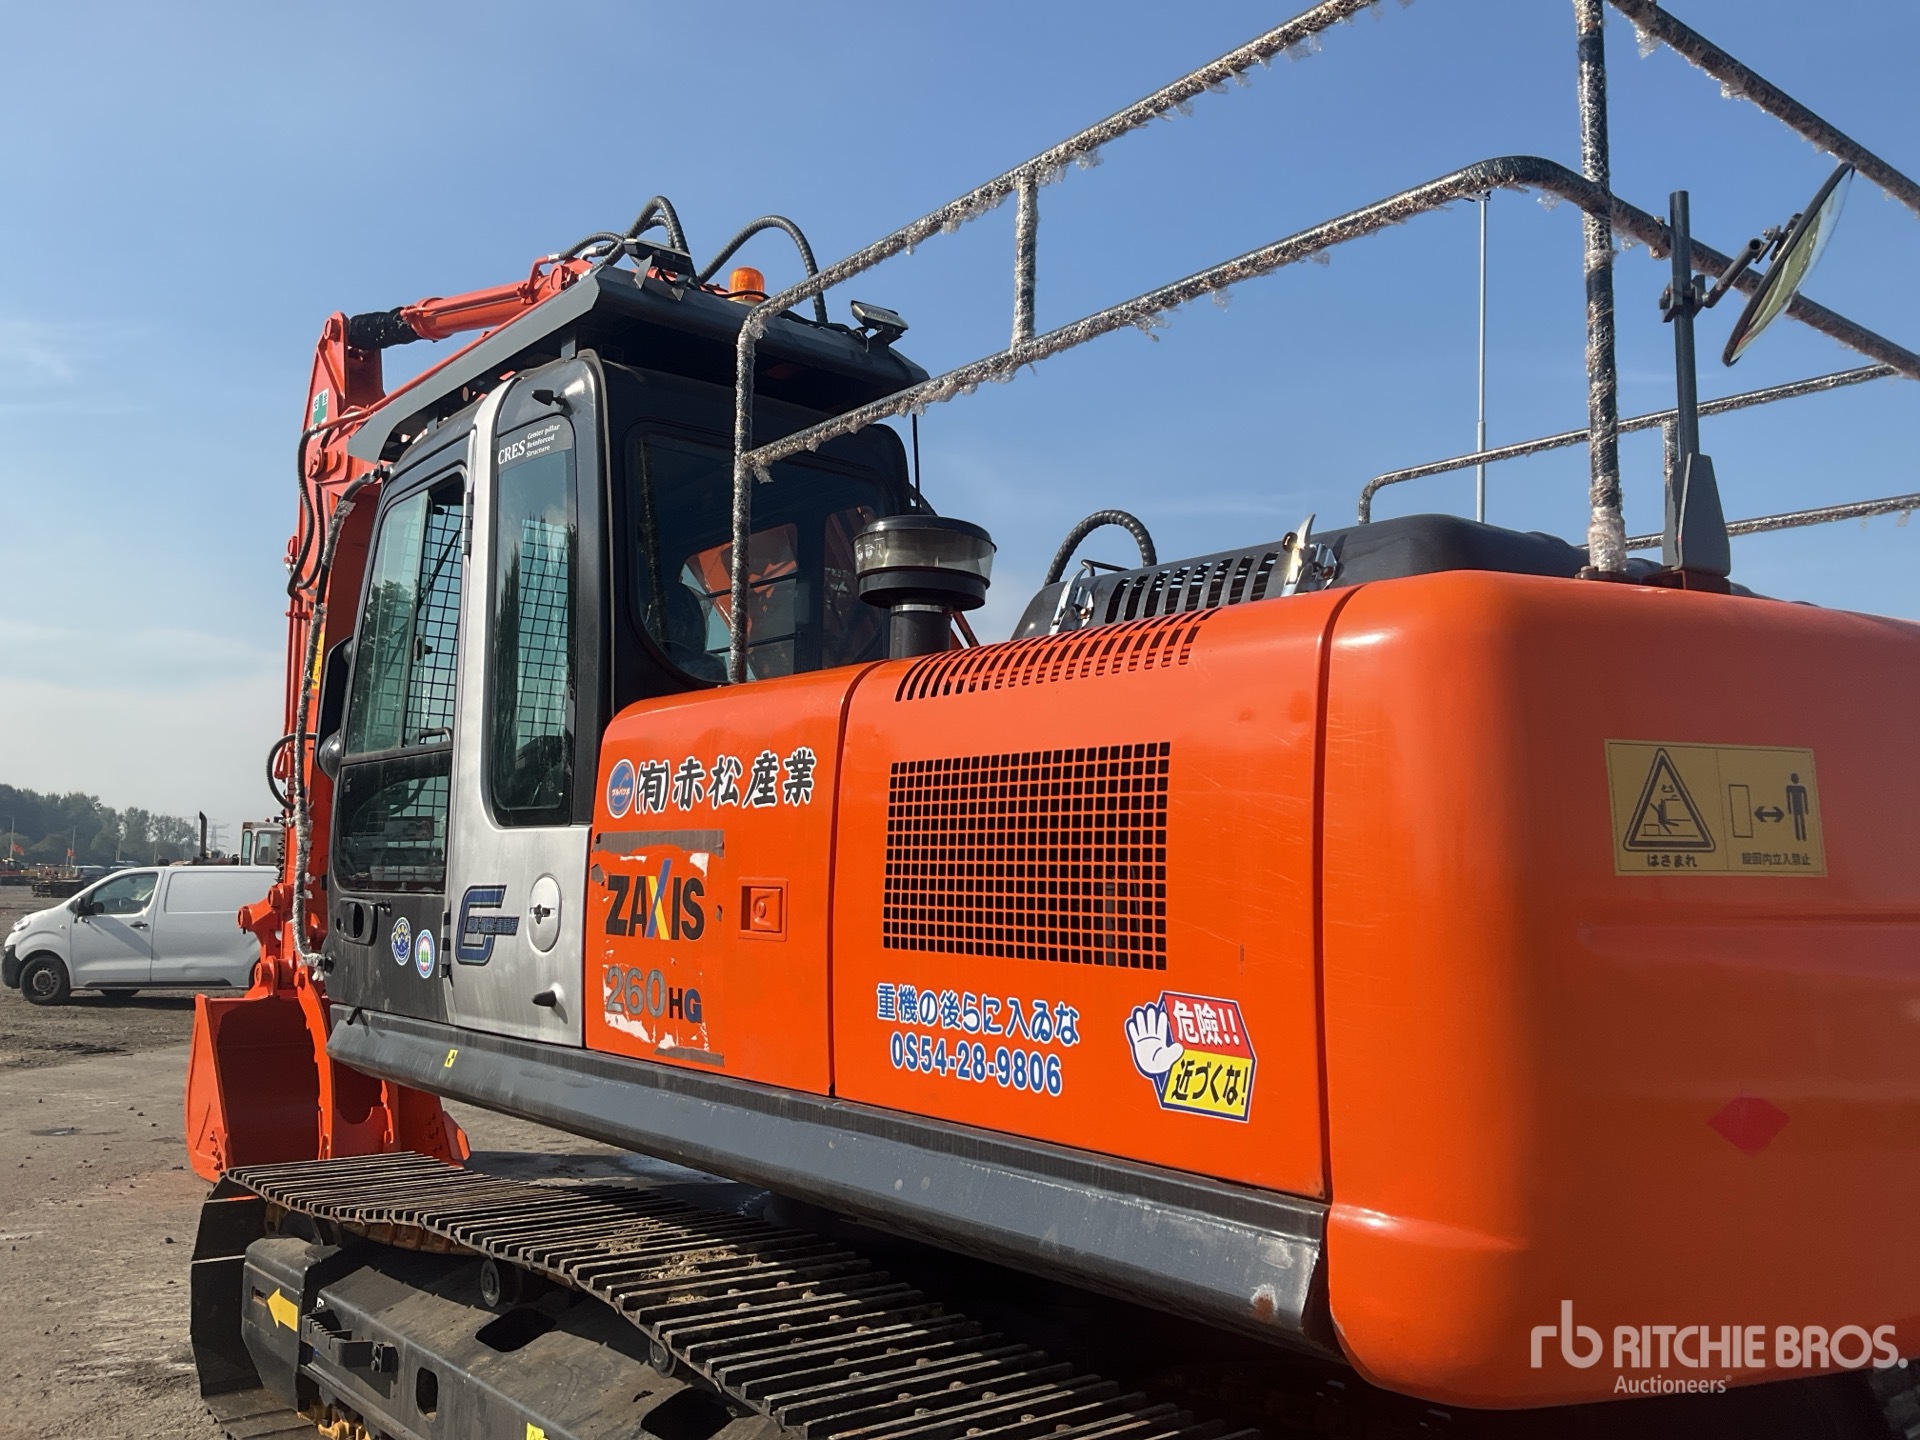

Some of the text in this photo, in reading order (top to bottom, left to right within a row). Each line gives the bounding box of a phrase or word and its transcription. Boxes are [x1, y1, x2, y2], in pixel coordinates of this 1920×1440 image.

[498, 440, 526, 465] CRES
[1647, 854, 1698, 868] はさまれ
[605, 859, 705, 941] ZAXIS
